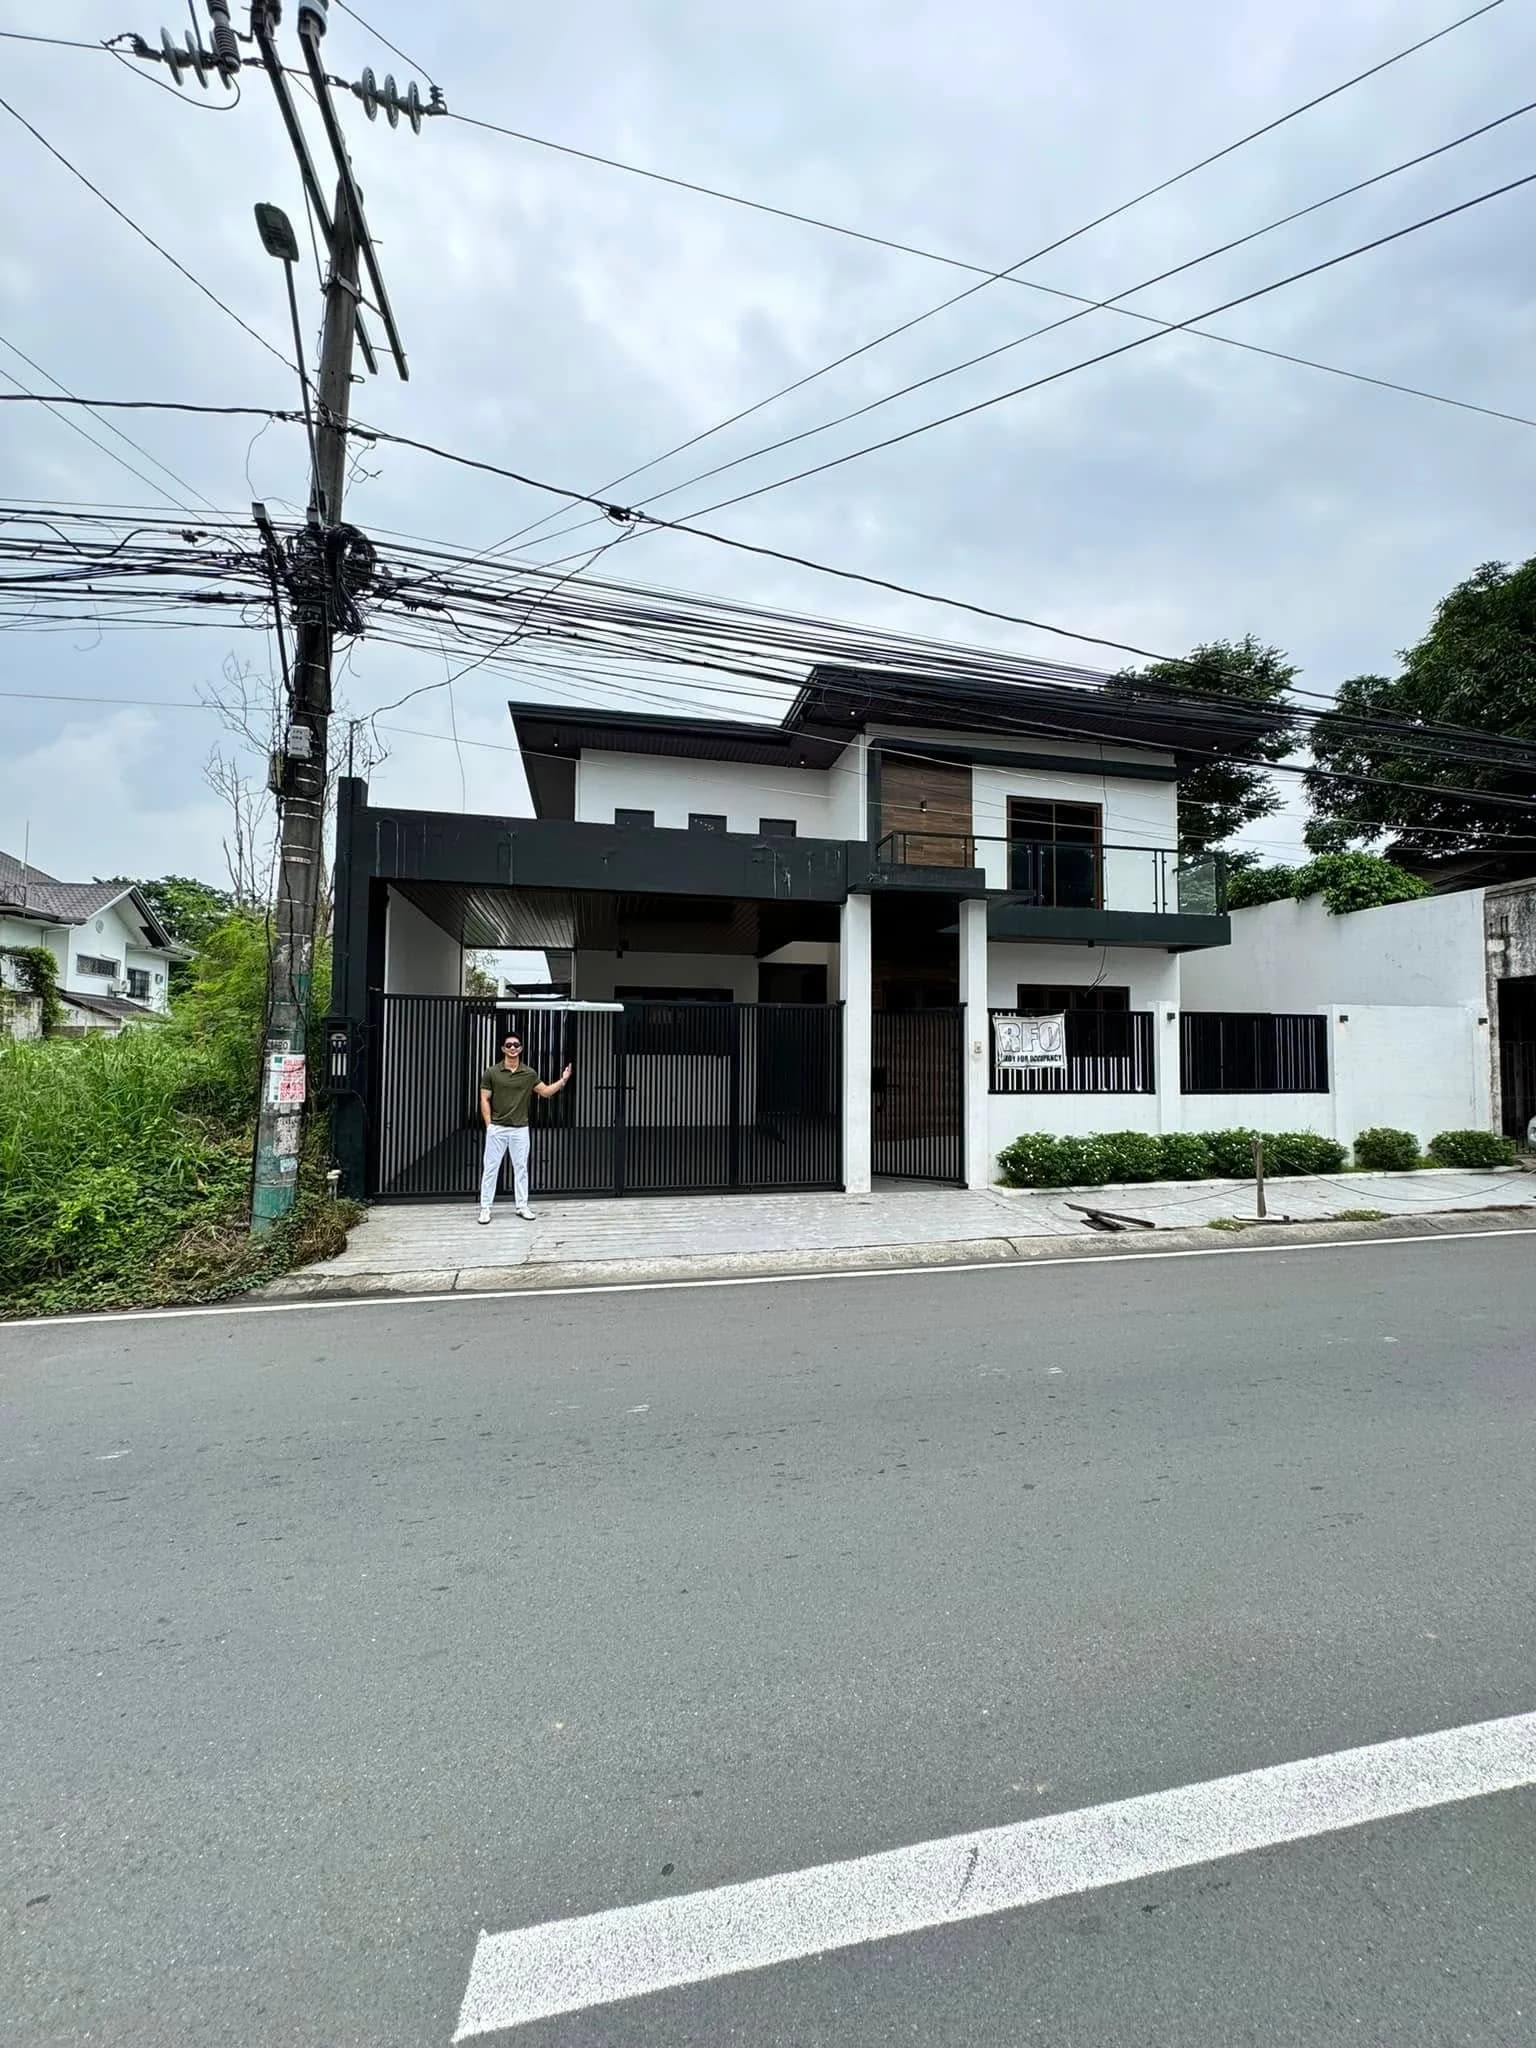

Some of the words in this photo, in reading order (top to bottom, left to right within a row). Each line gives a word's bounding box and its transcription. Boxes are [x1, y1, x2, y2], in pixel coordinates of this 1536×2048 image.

[998, 1021, 1061, 1052] RFO
[1017, 1055, 1029, 1063] FOR
[1030, 1054, 1062, 1062] OCCUPANCY
